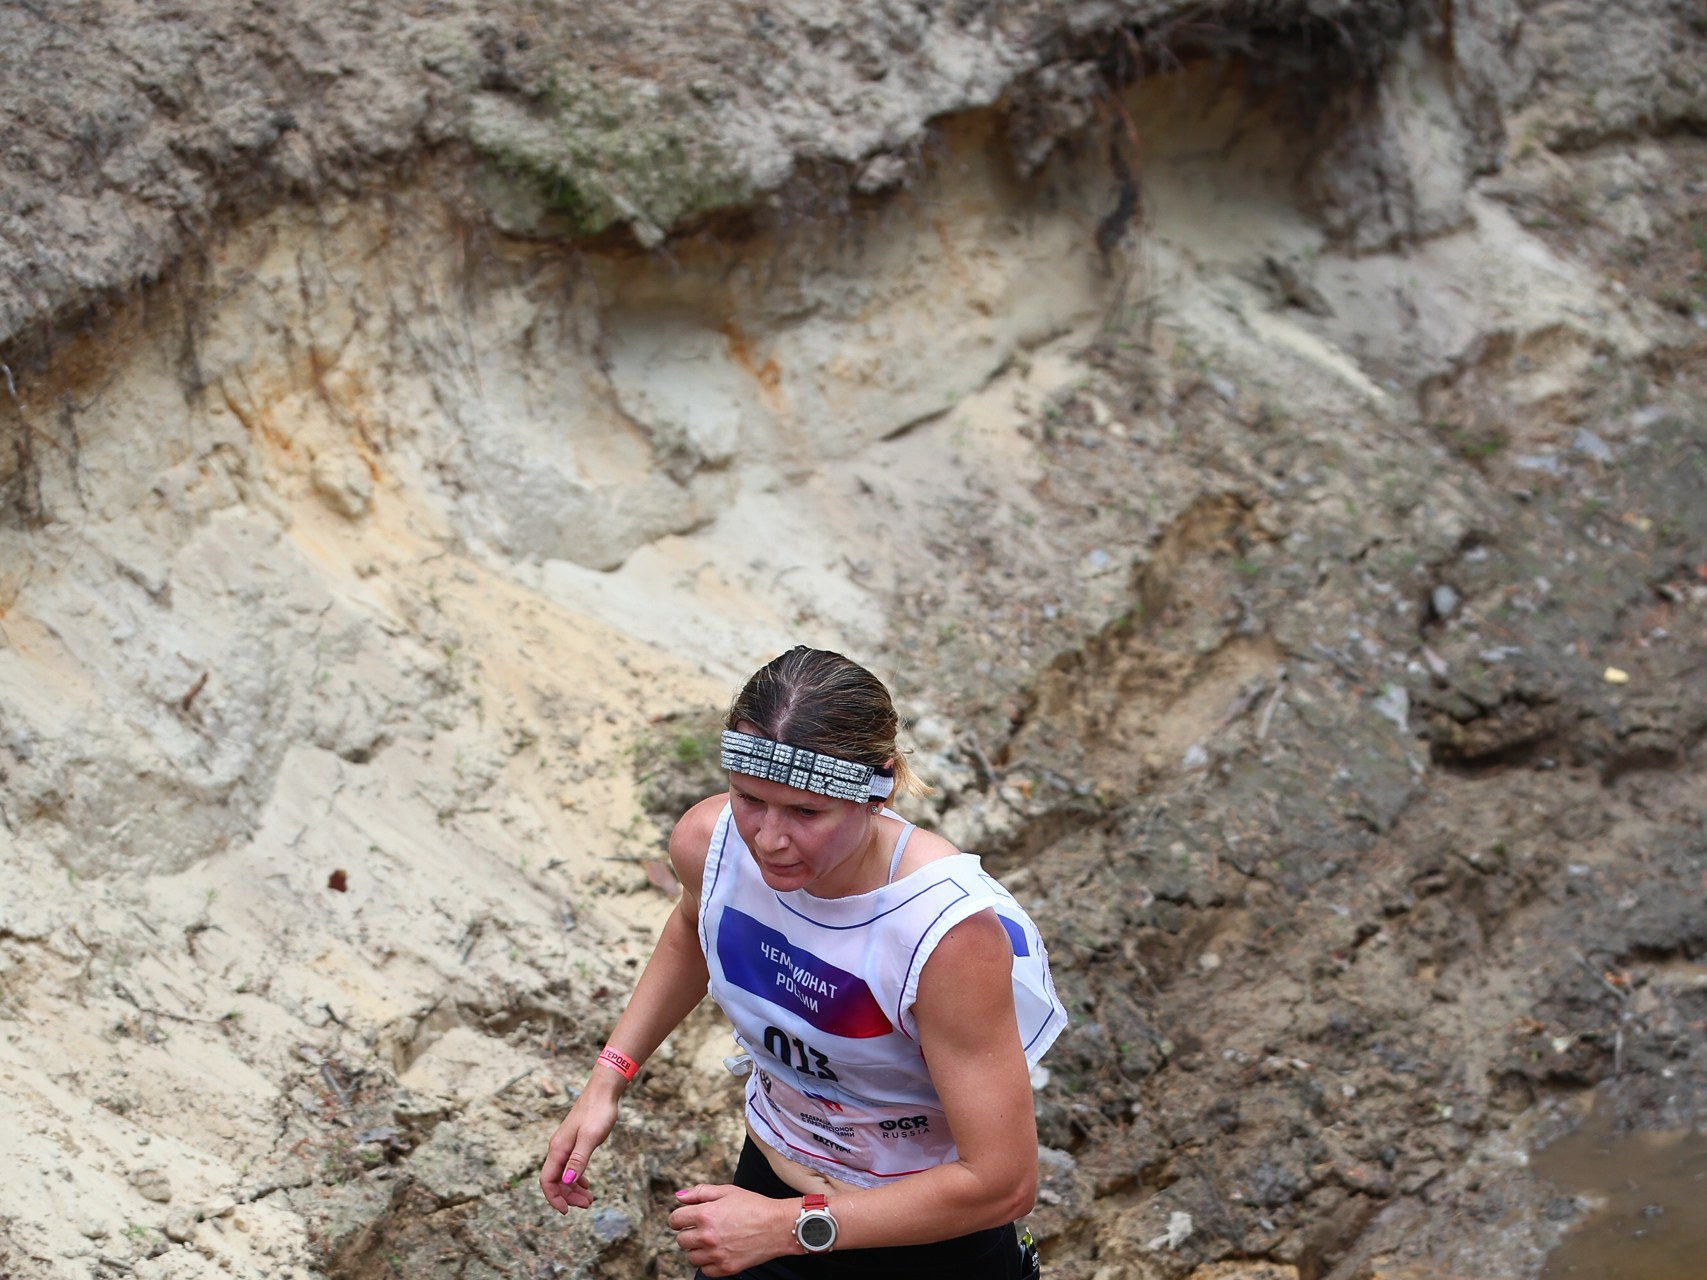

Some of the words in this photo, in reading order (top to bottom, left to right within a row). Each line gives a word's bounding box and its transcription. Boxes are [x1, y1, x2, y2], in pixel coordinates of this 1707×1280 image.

[764, 1026, 839, 1082] 013
[879, 1115, 929, 1131] OCR
[882, 1127, 931, 1139] RUSSIA
